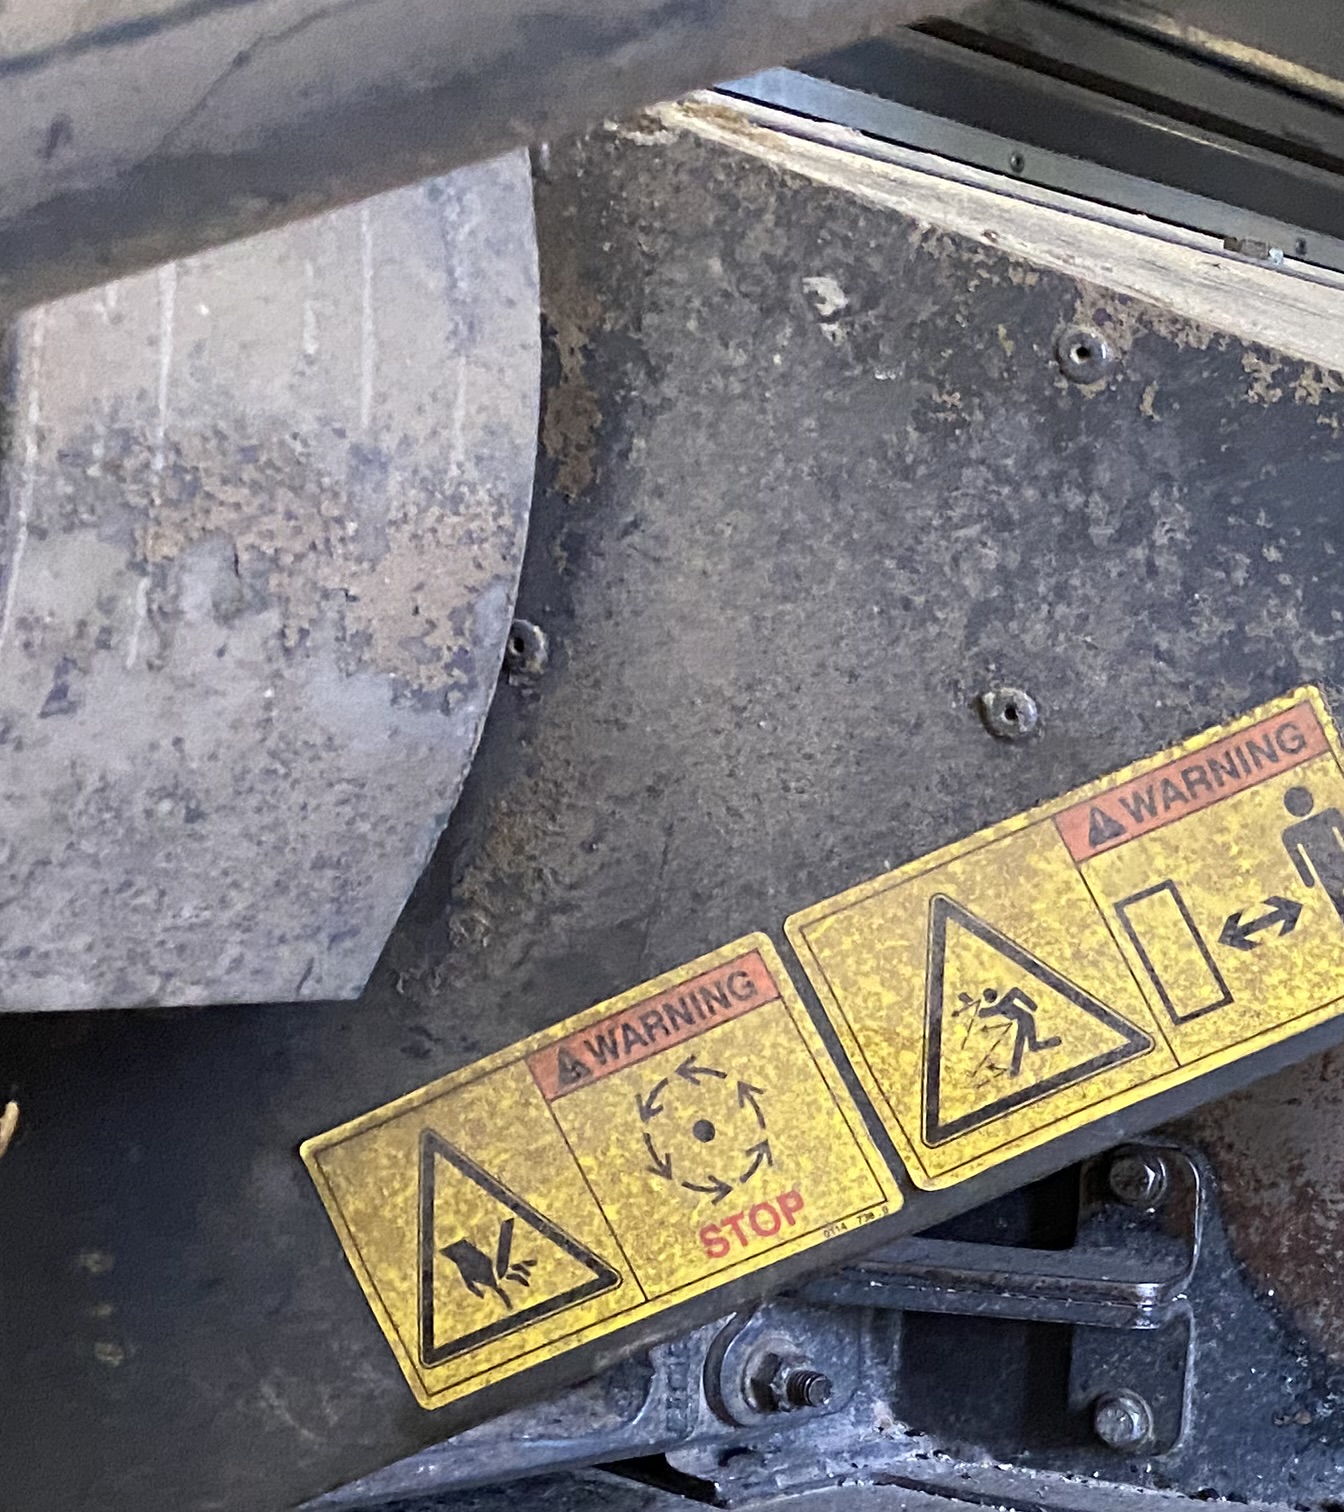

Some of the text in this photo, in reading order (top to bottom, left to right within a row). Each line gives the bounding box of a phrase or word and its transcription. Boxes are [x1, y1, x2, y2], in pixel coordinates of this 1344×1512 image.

[1119, 721, 1307, 824] WARNING
[583, 970, 758, 1066] WARNING
[700, 1189, 804, 1259] STOP
